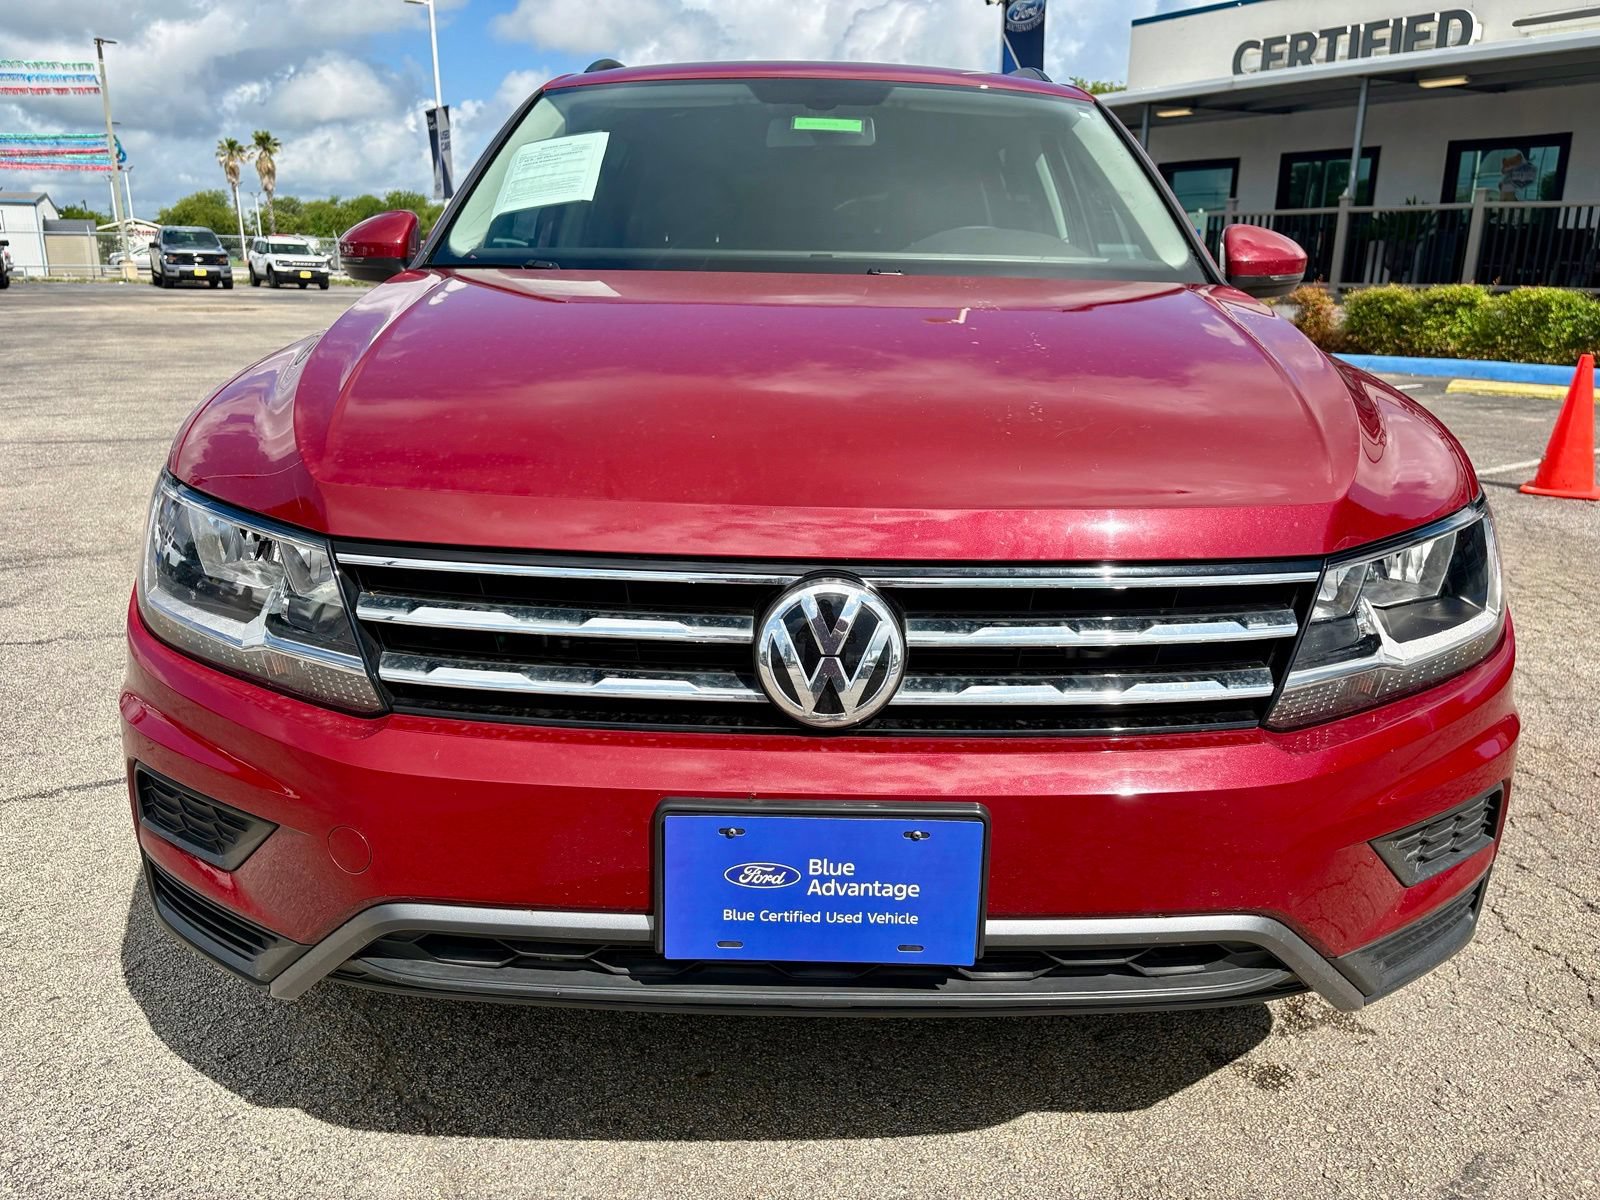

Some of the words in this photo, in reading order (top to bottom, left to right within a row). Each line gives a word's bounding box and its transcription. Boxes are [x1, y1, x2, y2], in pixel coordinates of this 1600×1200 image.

[1232, 9, 1476, 75] CERTIFIED
[738, 865, 785, 886] Ford
[808, 858, 856, 876] Blue
[807, 879, 921, 901] Advantage
[723, 909, 755, 921] Blue
[759, 910, 821, 923] Certified
[826, 911, 863, 924] Used
[867, 912, 919, 925] Vehicle
